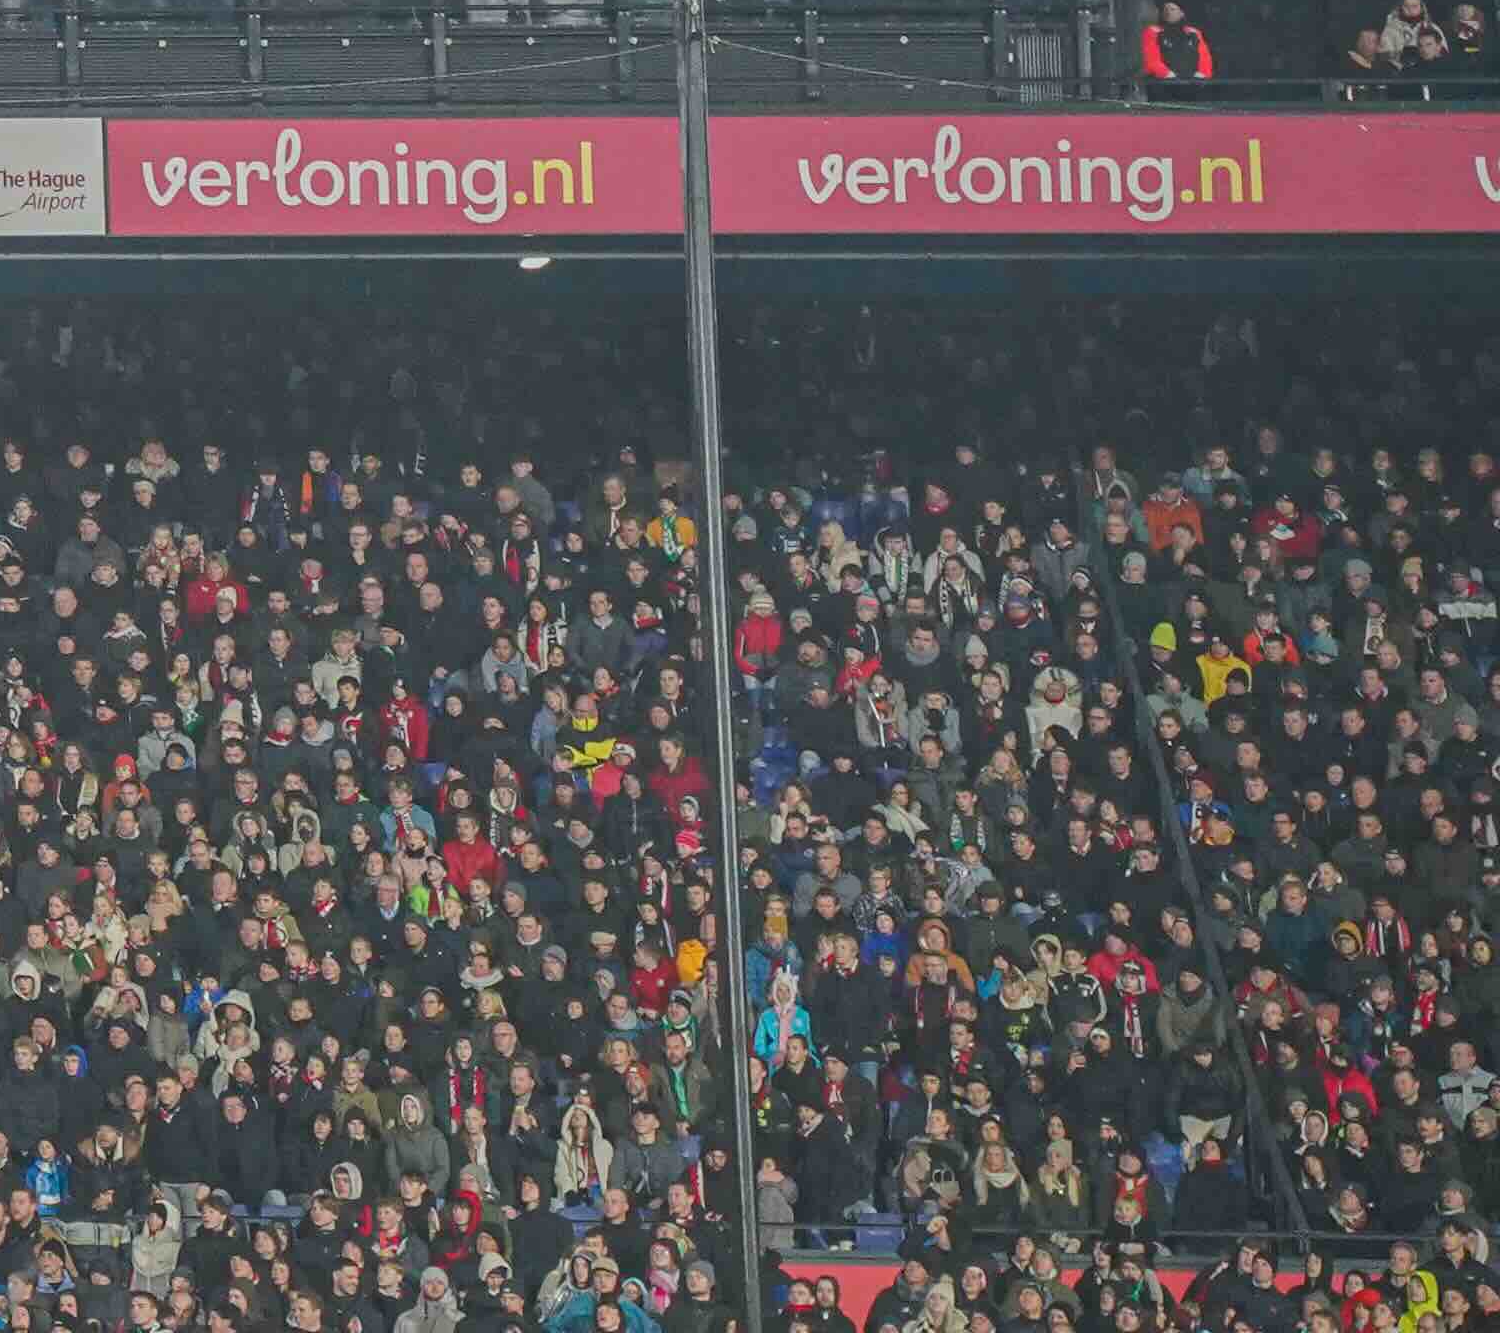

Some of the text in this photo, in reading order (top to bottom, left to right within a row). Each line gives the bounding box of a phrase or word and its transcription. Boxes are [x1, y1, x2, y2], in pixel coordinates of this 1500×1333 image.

[21, 191, 87, 214] Airport
[28, 170, 86, 195] Hague
[142, 128, 596, 224] verloning.nl
[798, 124, 1264, 222] verloning.nl
